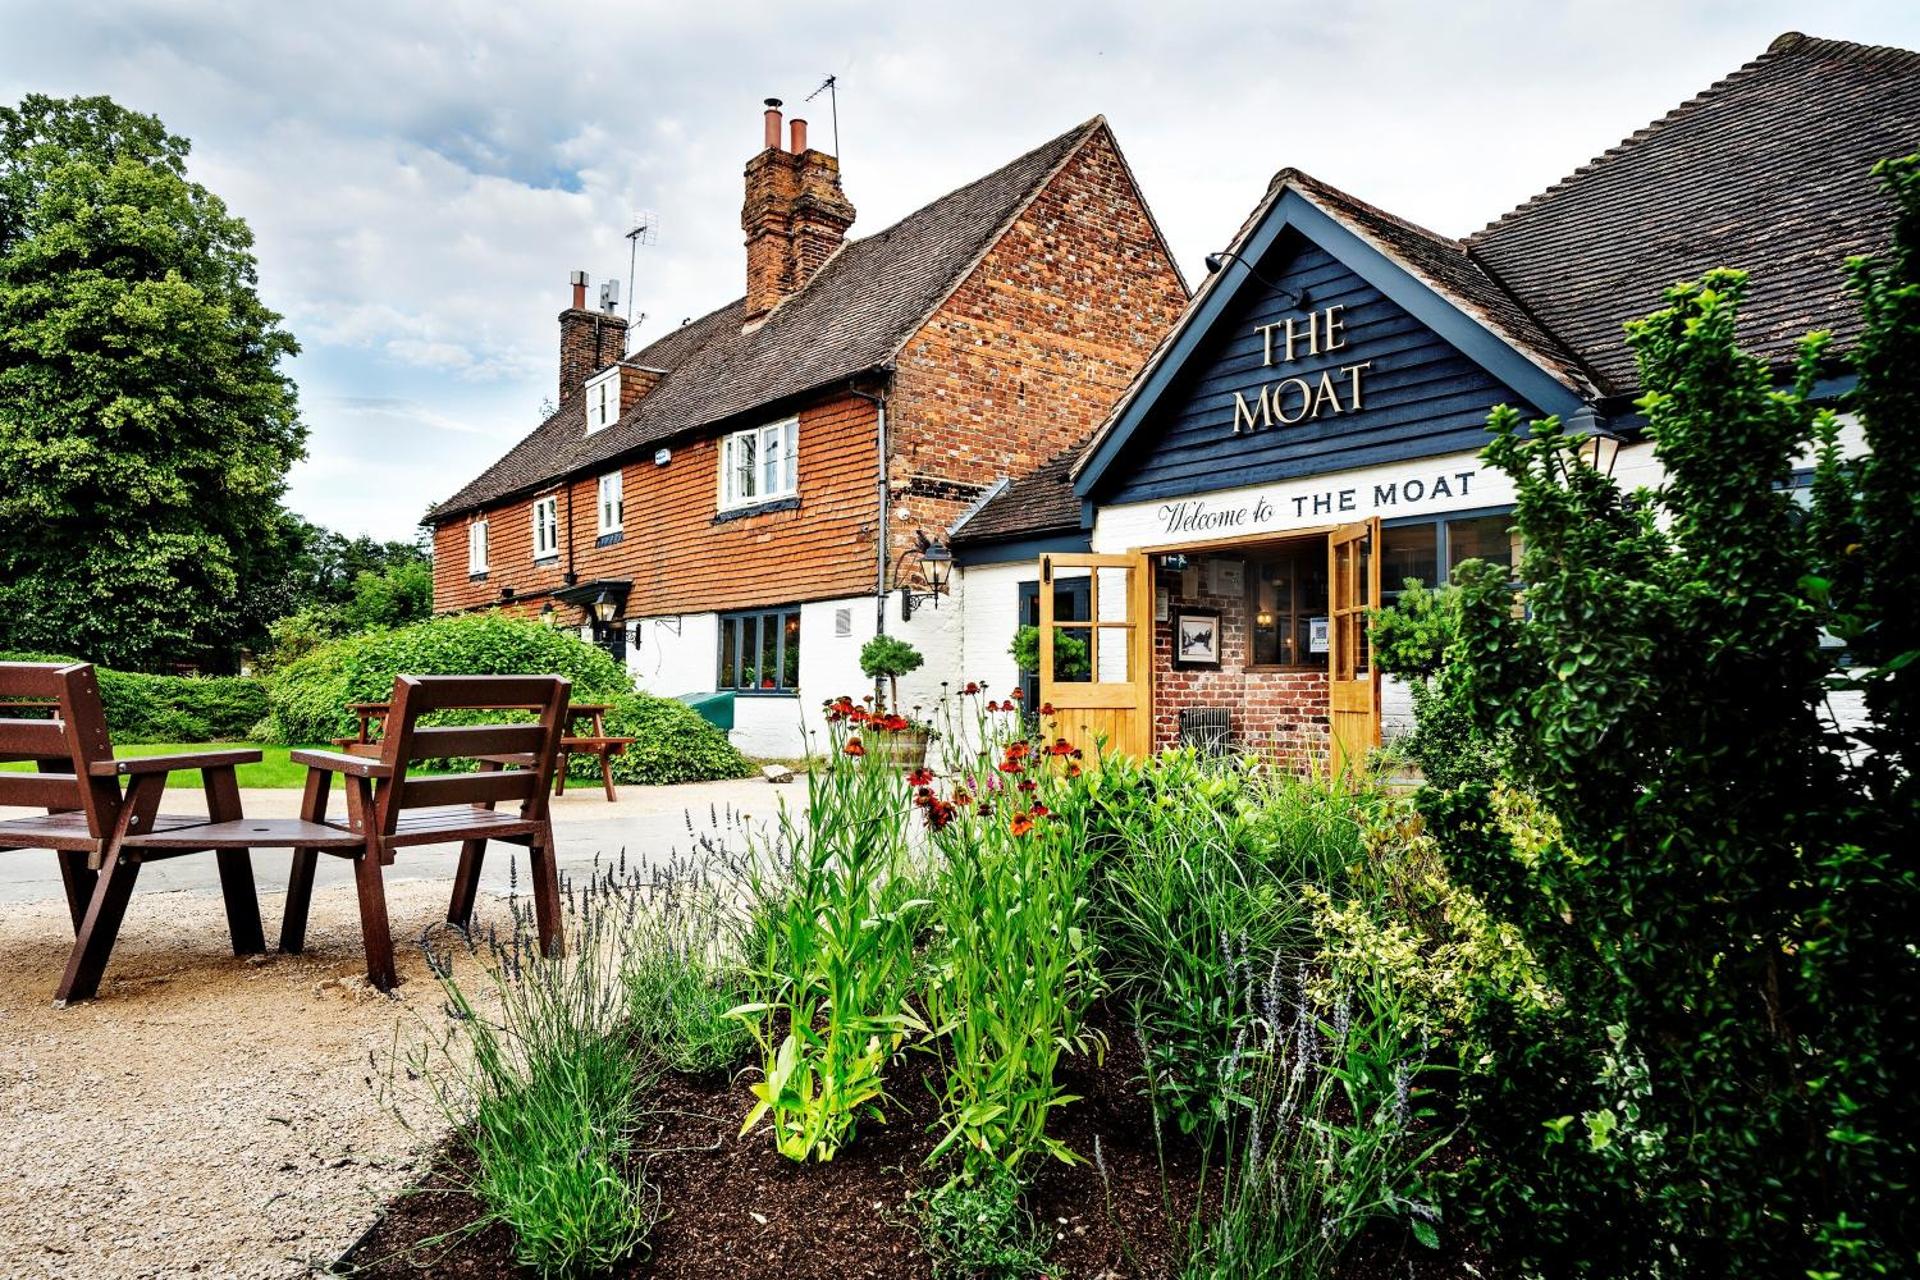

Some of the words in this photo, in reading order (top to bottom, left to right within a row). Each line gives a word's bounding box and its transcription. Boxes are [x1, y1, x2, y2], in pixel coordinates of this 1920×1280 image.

[1254, 304, 1346, 367] THE
[1232, 360, 1371, 433] MOAT
[1157, 502, 1247, 534] Welcome
[1252, 494, 1276, 524] to
[1291, 489, 1358, 518] THE
[1373, 471, 1476, 508] MOAT
